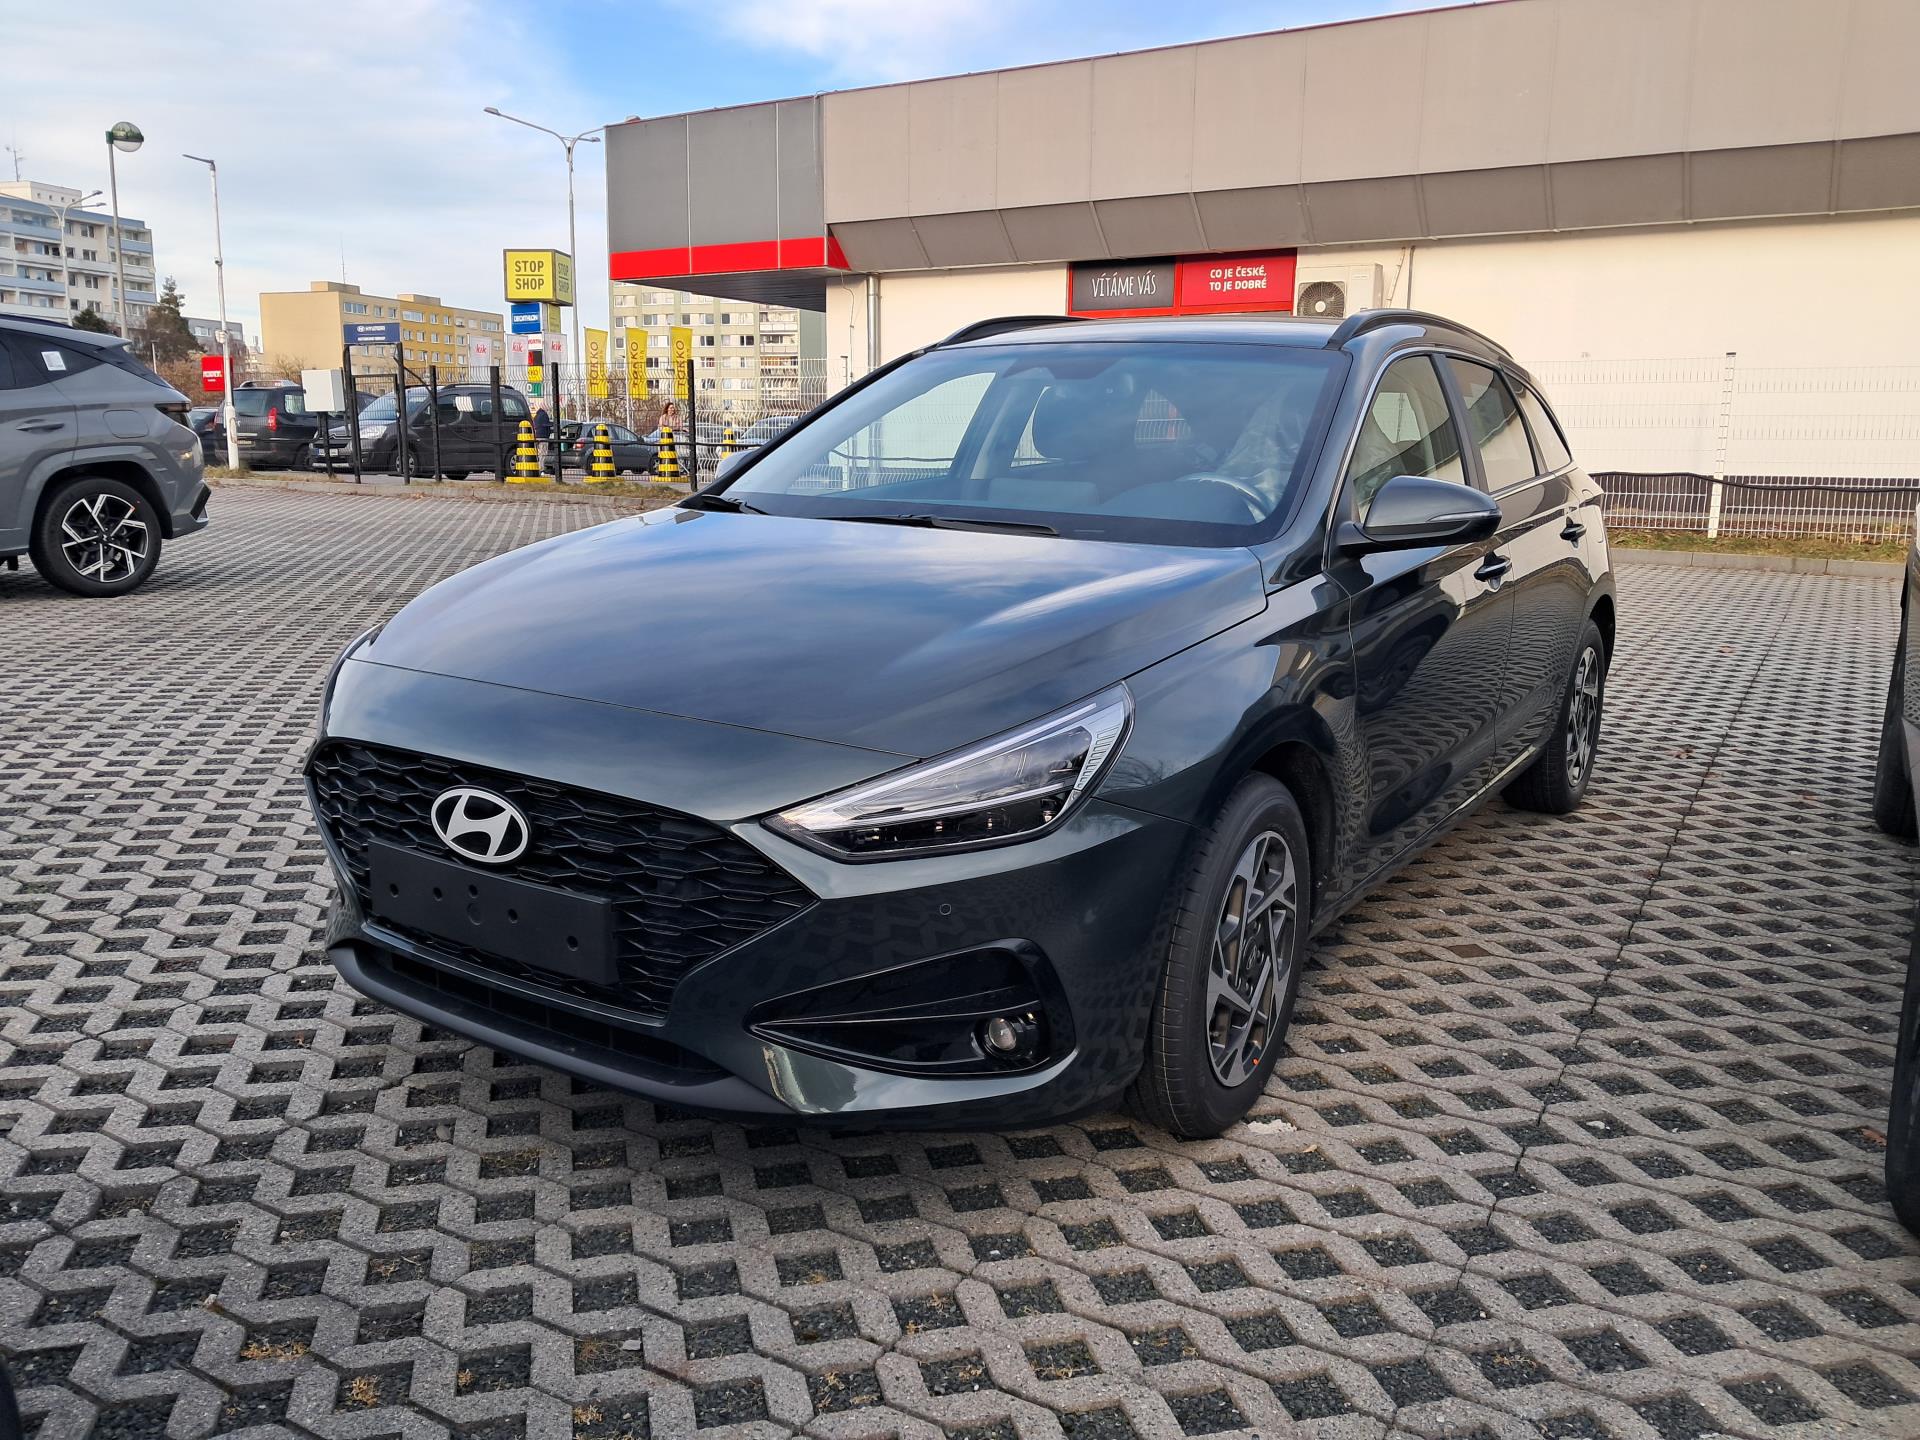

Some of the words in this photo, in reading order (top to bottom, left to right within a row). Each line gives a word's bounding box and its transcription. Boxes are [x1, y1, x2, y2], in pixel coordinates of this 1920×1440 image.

[514, 260, 544, 273] STOP
[1210, 269, 1222, 279] CO
[1224, 268, 1233, 279] JE
[1235, 265, 1267, 277] ČESKÉ,
[515, 278, 545, 290] SHOP
[1091, 271, 1134, 297] VÍTÁME
[1137, 270, 1156, 295] VÁS
[1209, 281, 1222, 291] TO
[1223, 281, 1233, 292] JE
[1234, 277, 1267, 290] DOBRÉ
